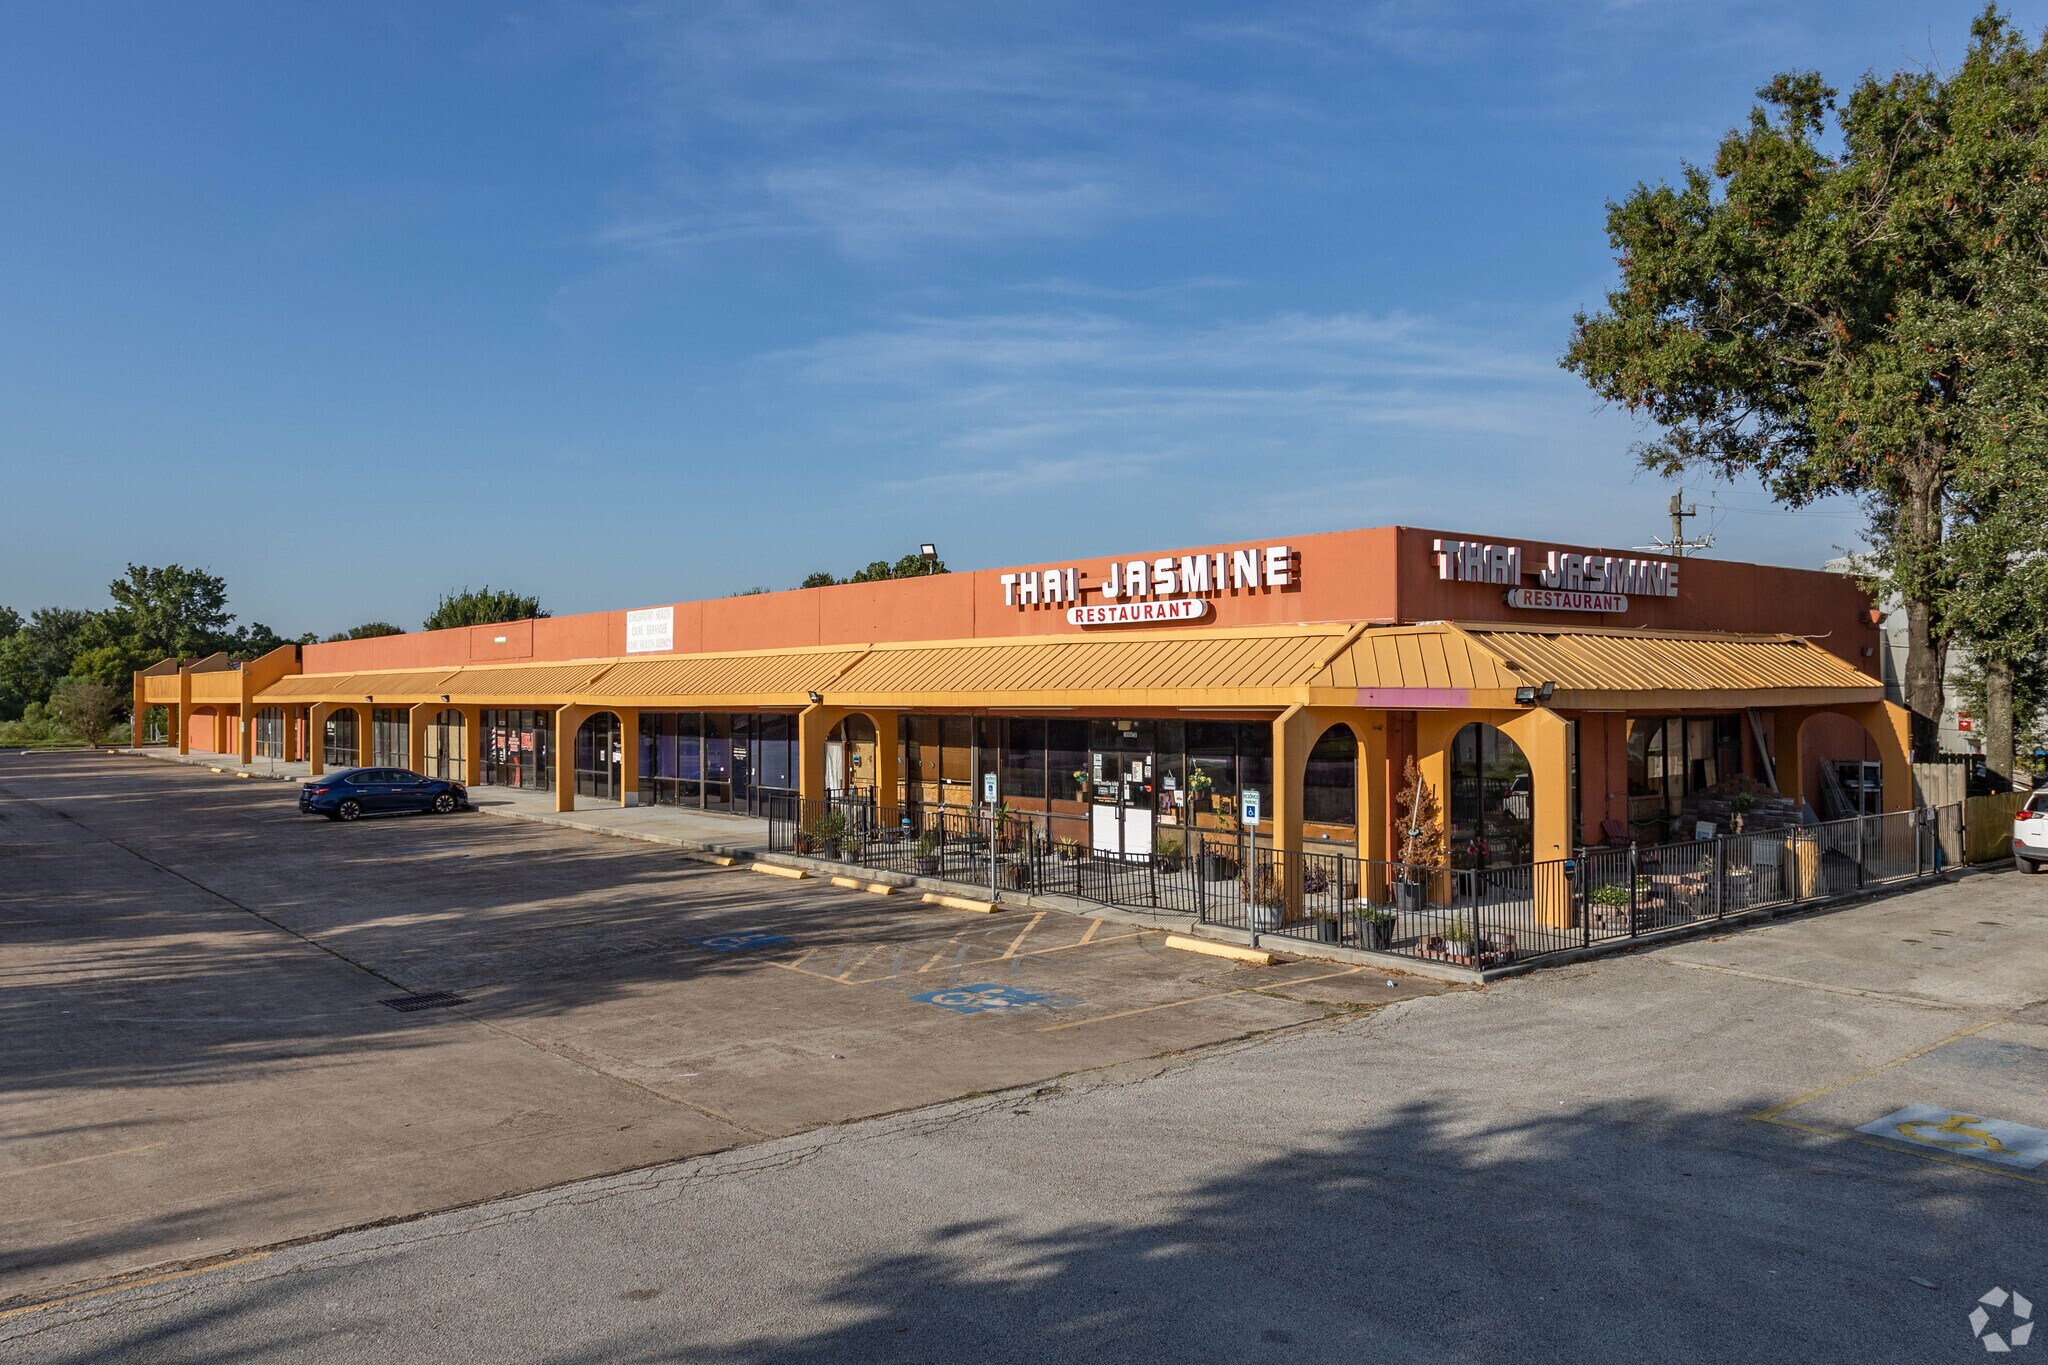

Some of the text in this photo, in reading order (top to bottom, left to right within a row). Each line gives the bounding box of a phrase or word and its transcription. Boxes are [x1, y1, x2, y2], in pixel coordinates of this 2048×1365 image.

[1000, 546, 1292, 606] THAI JASMINE
[1433, 538, 1679, 597] THAI JASMINE
[1075, 601, 1193, 623] RESTAURANT
[1523, 590, 1622, 611] RESTAURANT
